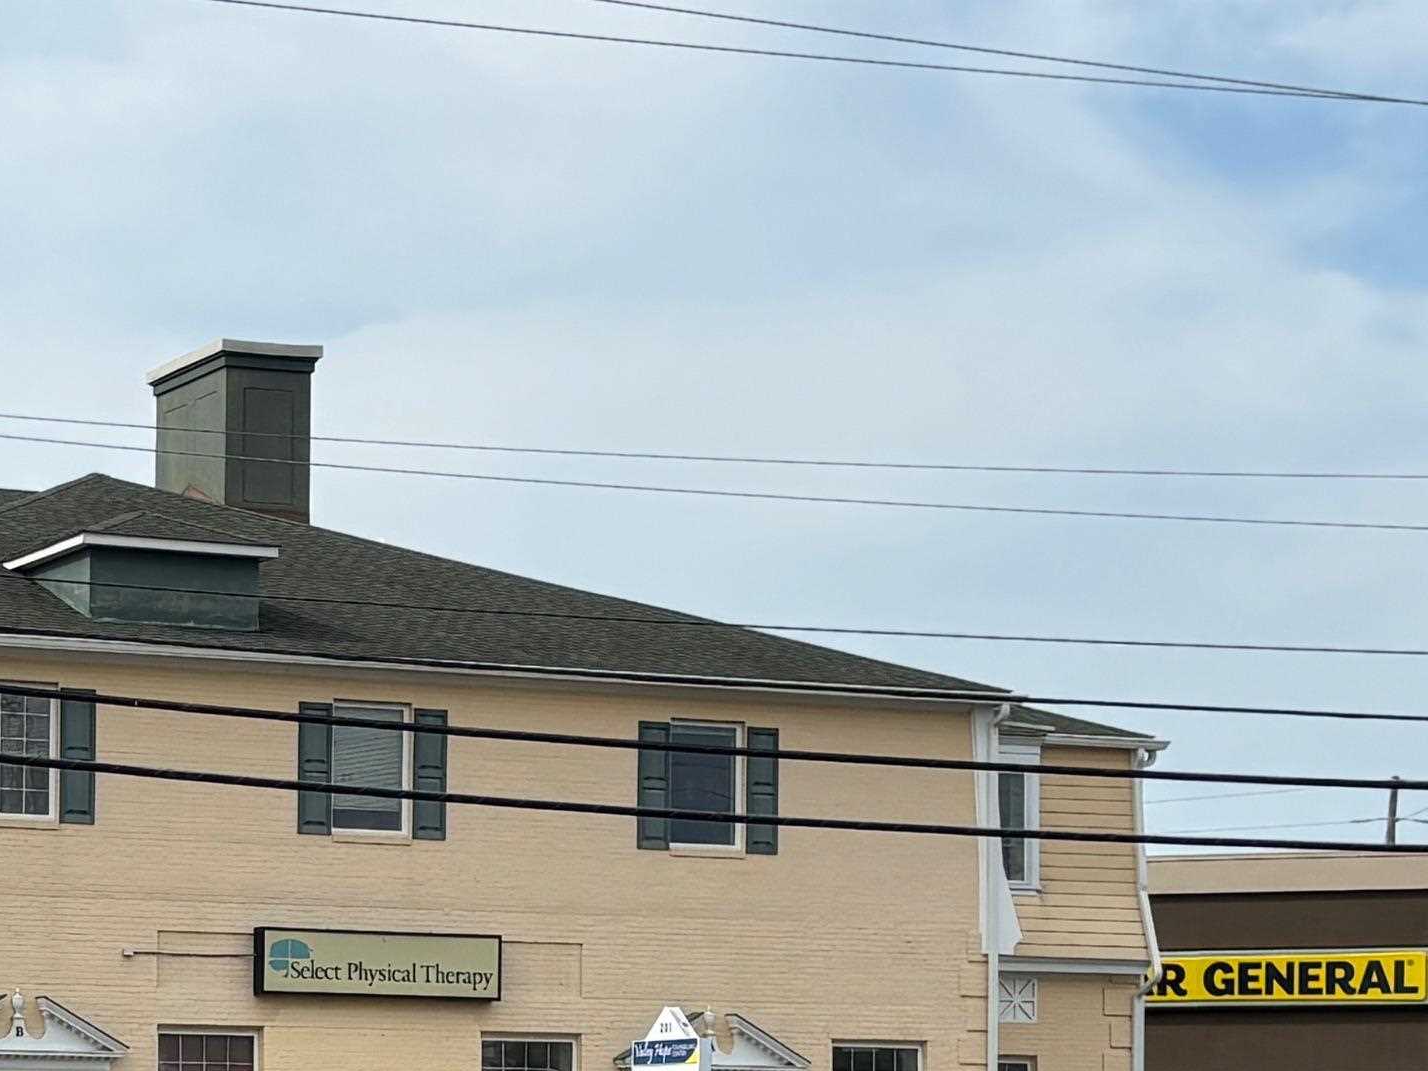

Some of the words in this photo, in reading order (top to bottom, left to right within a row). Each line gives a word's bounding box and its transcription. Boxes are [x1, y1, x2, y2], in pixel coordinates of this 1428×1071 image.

[290, 960, 342, 981] Select
[347, 961, 417, 987] Physical
[421, 964, 494, 991] Therapy
[1203, 960, 1420, 997] GENERAL
